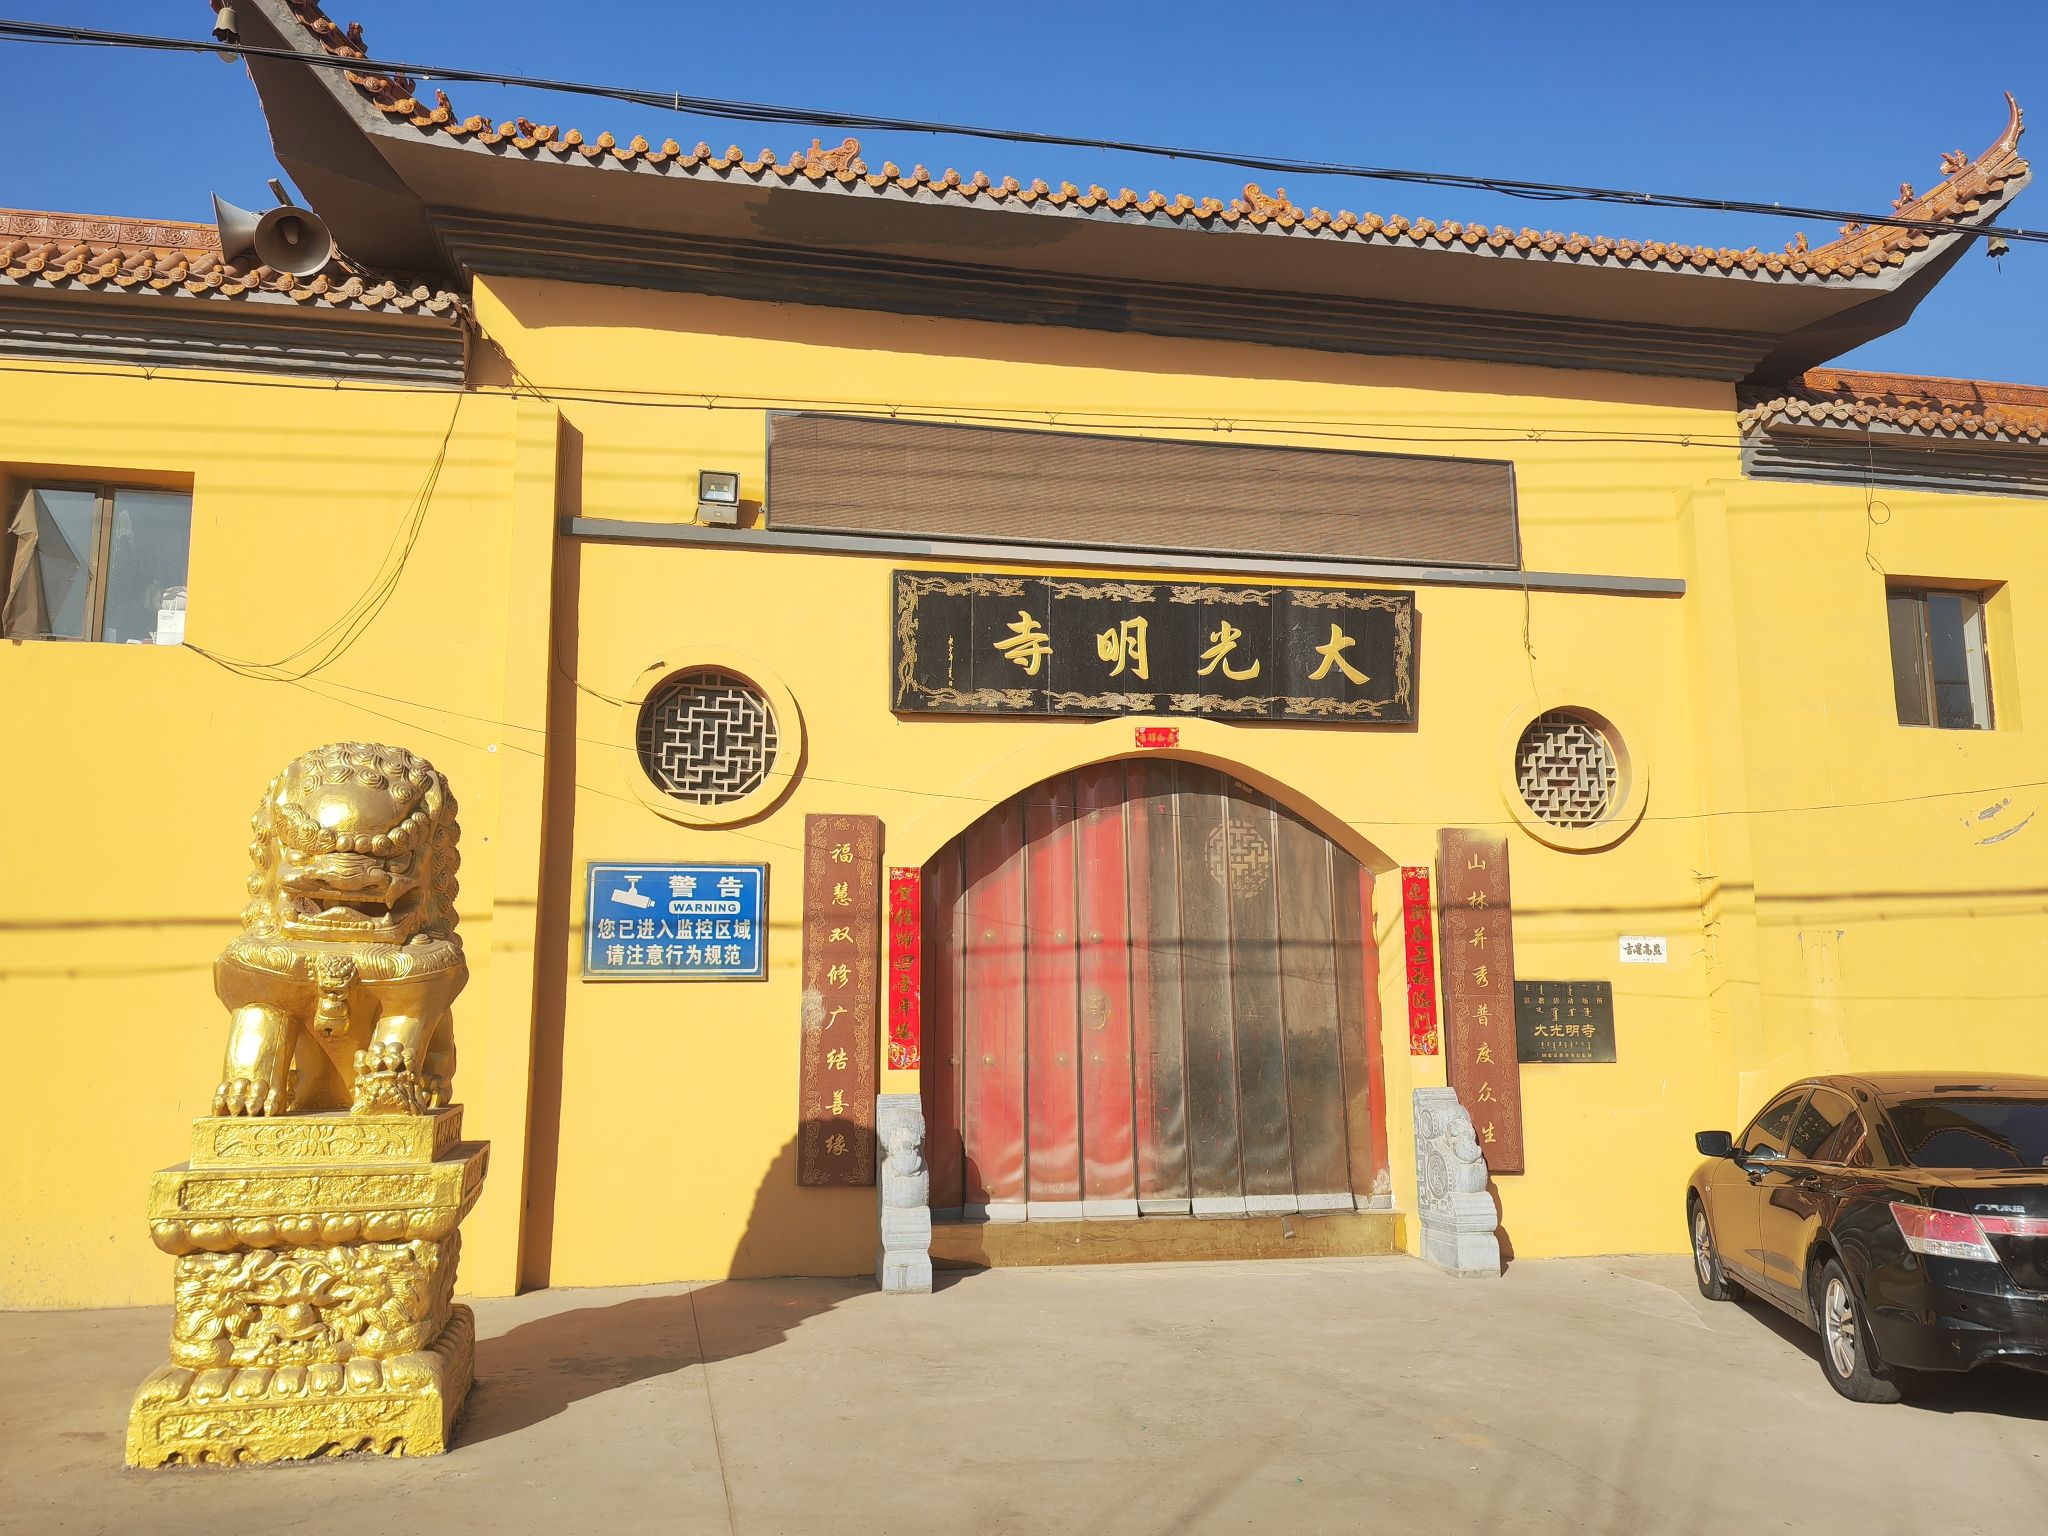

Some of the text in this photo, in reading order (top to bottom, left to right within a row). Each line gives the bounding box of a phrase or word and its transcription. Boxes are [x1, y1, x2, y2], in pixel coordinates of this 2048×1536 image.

[993, 609, 1371, 686] 大光明寺
[668, 875, 744, 898] 警告
[673, 903, 737, 912] WARNING
[597, 918, 752, 940] 您已进入监控区域
[606, 944, 741, 966] 请注意行为规范
[1534, 1024, 1595, 1037] 大光明寺
